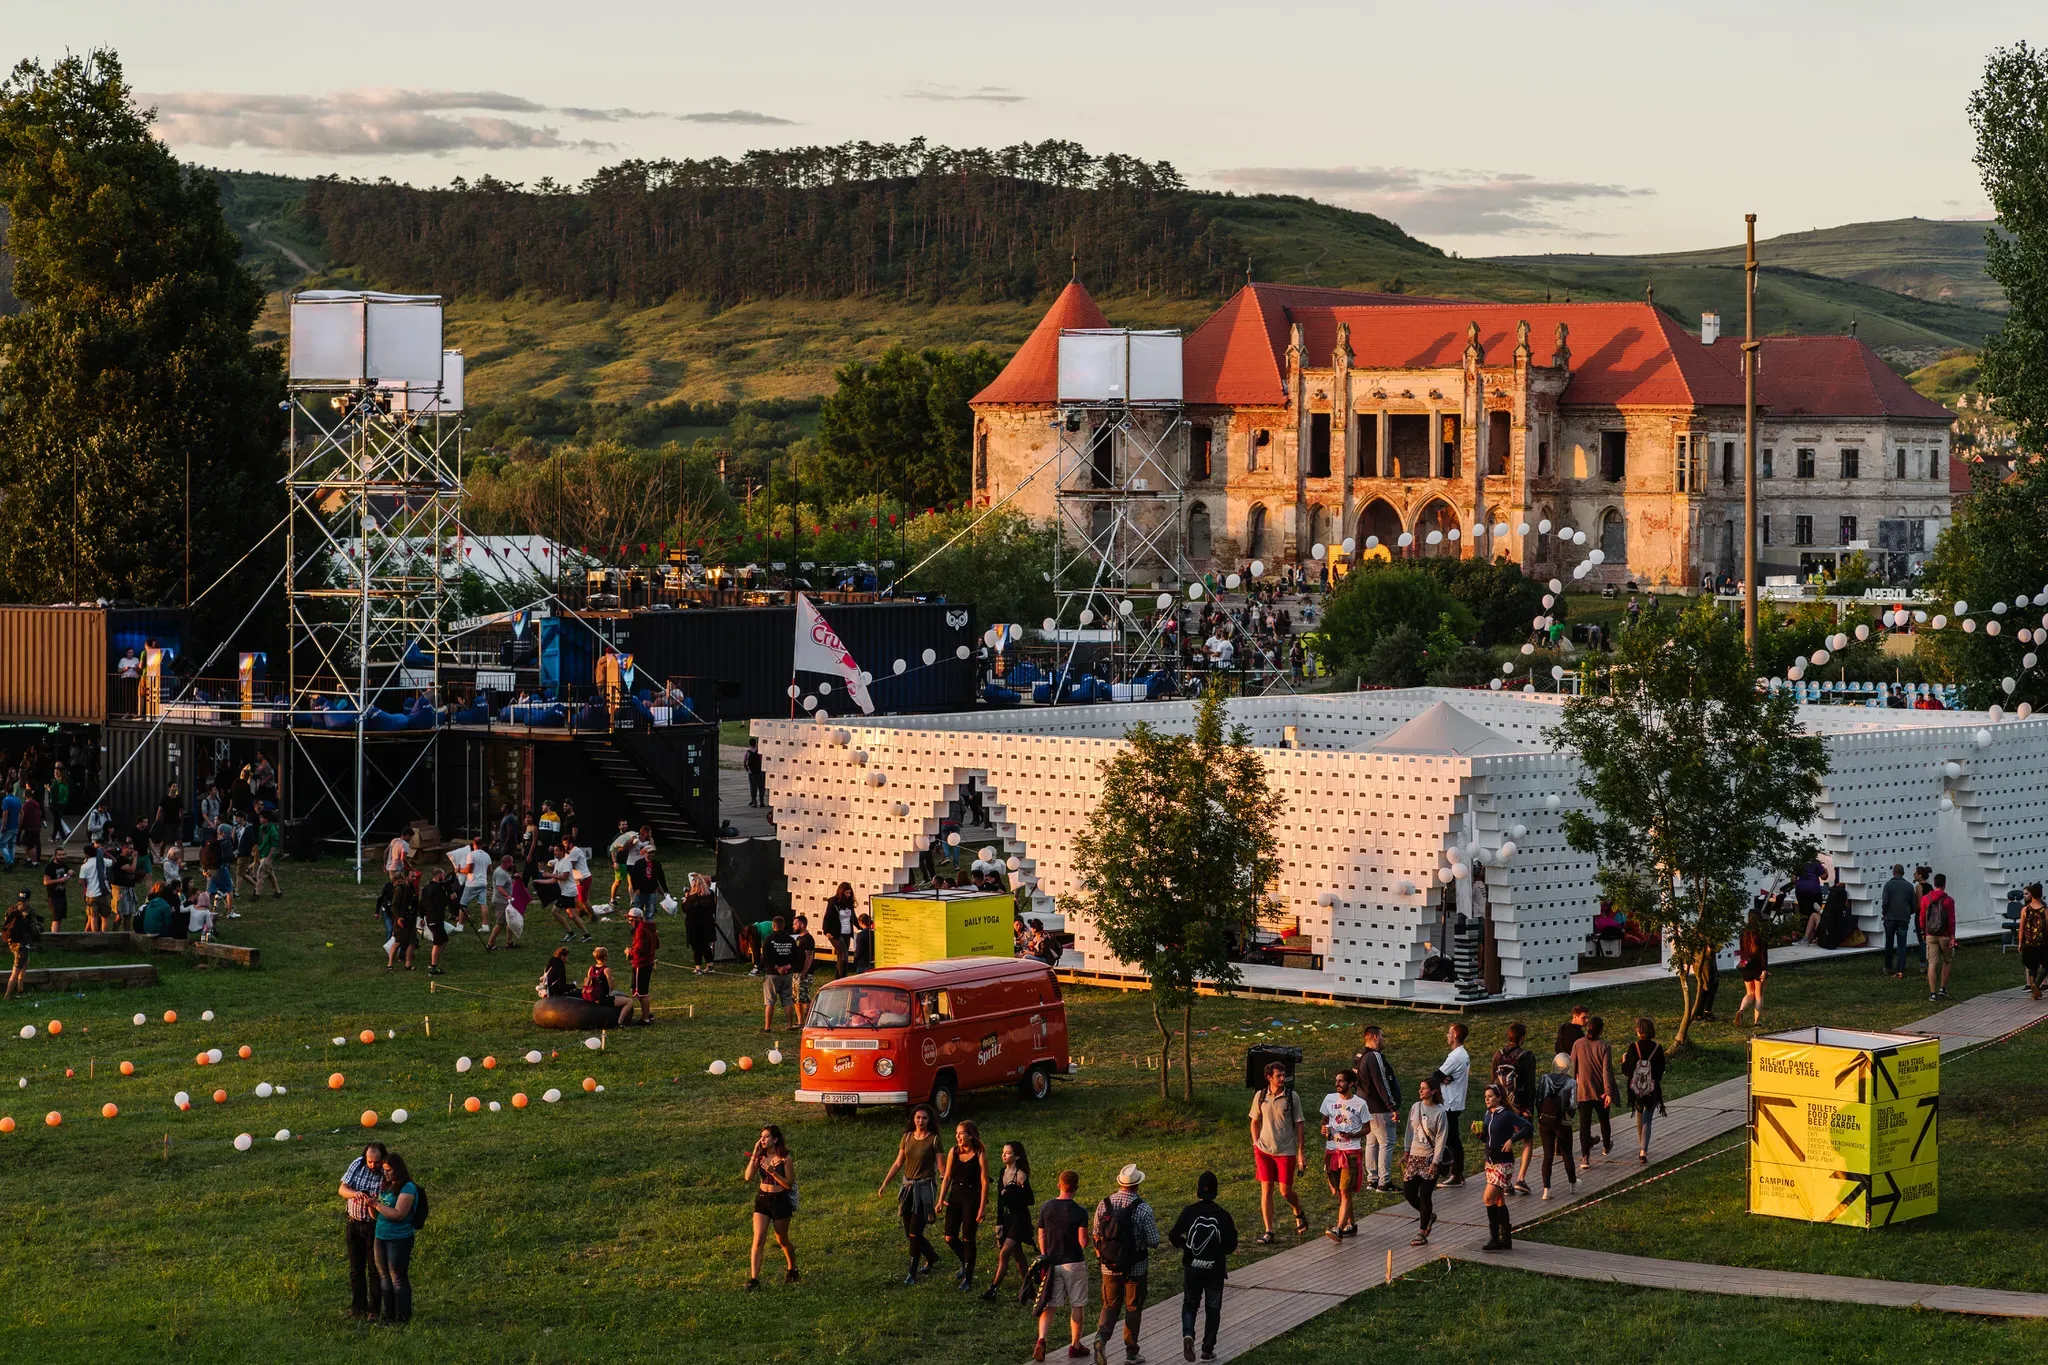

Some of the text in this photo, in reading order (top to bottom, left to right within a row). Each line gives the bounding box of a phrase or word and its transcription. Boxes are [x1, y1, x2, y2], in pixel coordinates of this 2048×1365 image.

[1863, 588, 1907, 600] APEROL
[452, 618, 483, 629] LOCKERS
[964, 915, 1000, 927] DAILY YOGA
[978, 1043, 1002, 1065] Spritz
[833, 1061, 854, 1072] Spritz
[1760, 1057, 1814, 1070] SILENT DANCE
[1911, 1057, 1924, 1065] STAGE
[1760, 1064, 1820, 1078] HIDEOUT STAGE
[1898, 1065, 1919, 1074] PREMIUM
[1808, 1103, 1837, 1113] TOILETS
[1808, 1111, 1856, 1123] FOOD COURT
[1808, 1118, 1860, 1131] BEER GARDEN
[1759, 1176, 1795, 1187] CAMPING
[1191, 1258, 1215, 1269] NIKE
